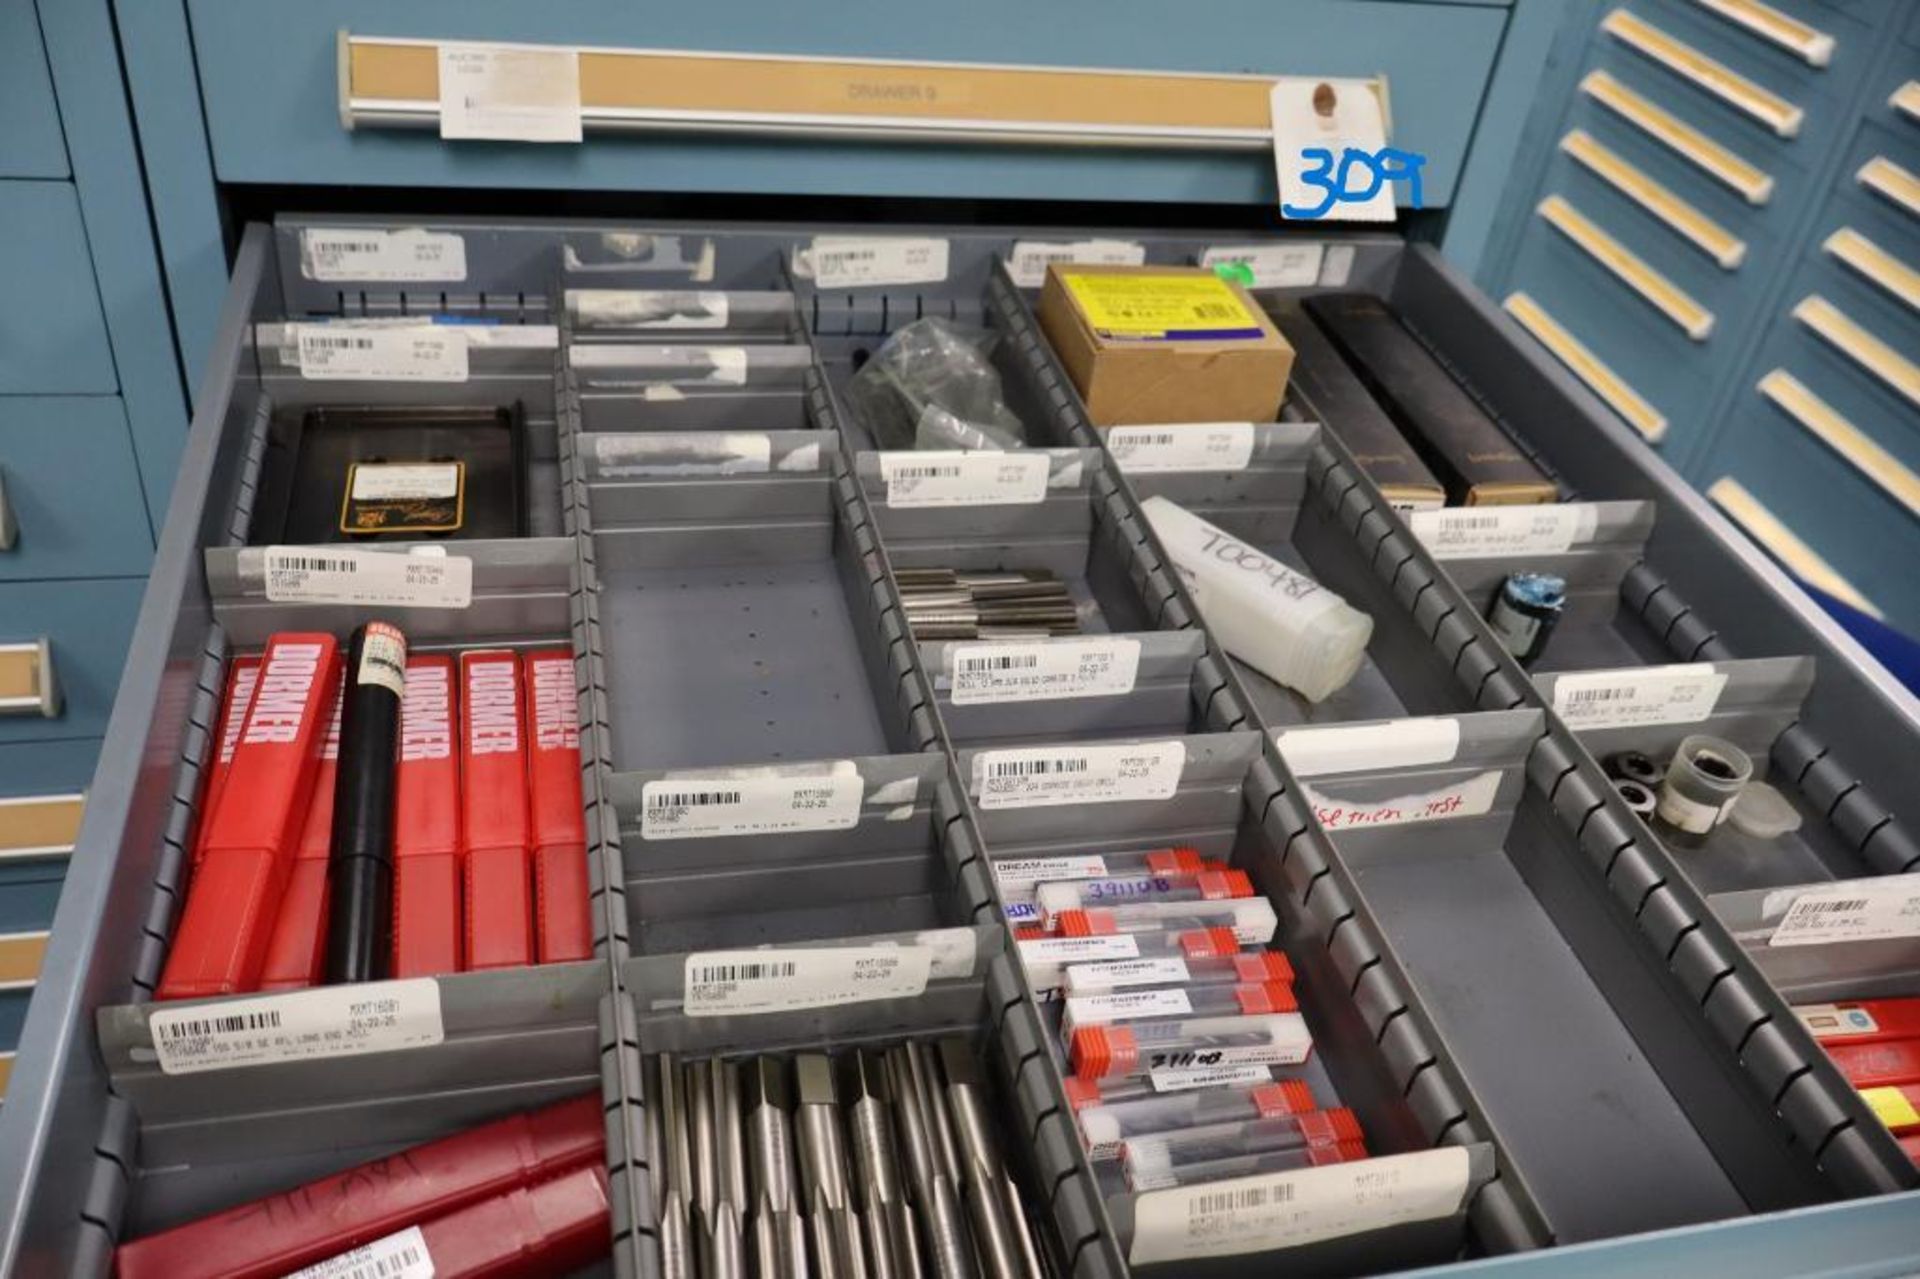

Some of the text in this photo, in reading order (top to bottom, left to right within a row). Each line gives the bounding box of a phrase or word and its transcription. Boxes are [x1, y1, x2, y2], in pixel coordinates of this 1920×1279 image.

[244, 643, 323, 745] DORMER
[401, 666, 451, 761] DORMER
[470, 661, 519, 756] DORMER
